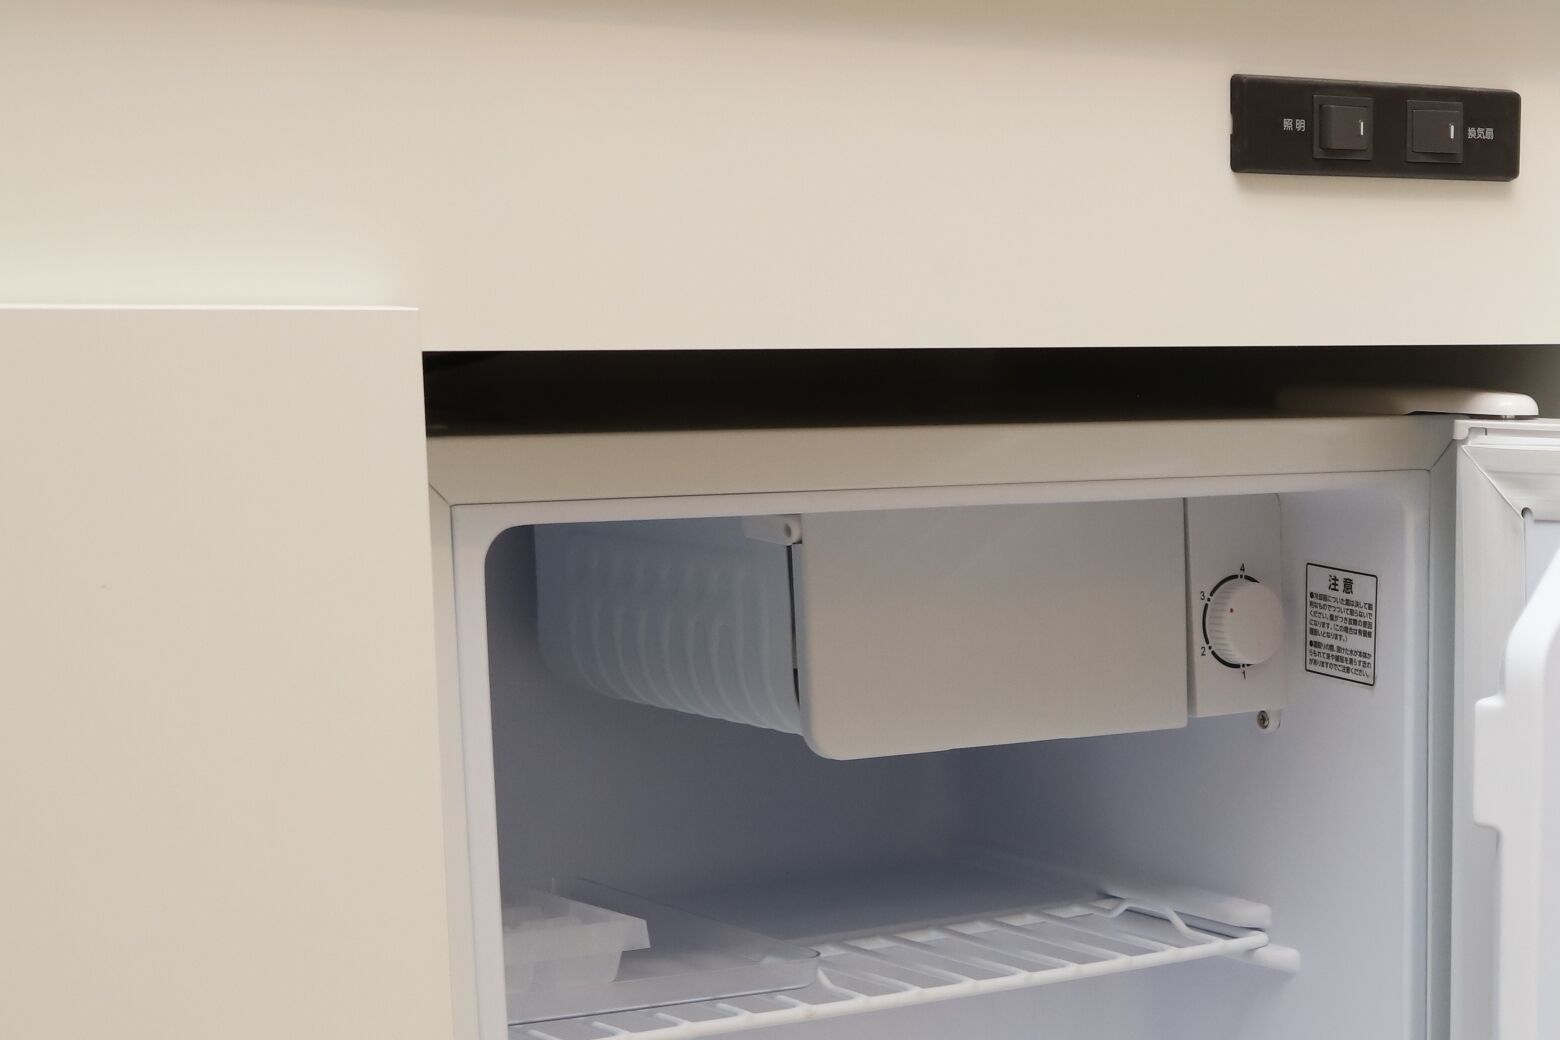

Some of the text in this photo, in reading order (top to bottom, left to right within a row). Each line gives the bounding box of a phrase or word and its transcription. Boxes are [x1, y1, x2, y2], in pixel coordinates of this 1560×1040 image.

[1283, 118, 1306, 132] 照明
[1467, 127, 1495, 140] 換気扇
[1240, 563, 1245, 573] 4
[1328, 574, 1354, 595] 注意
[1200, 591, 1206, 601] 3
[1200, 646, 1206, 657] 2
